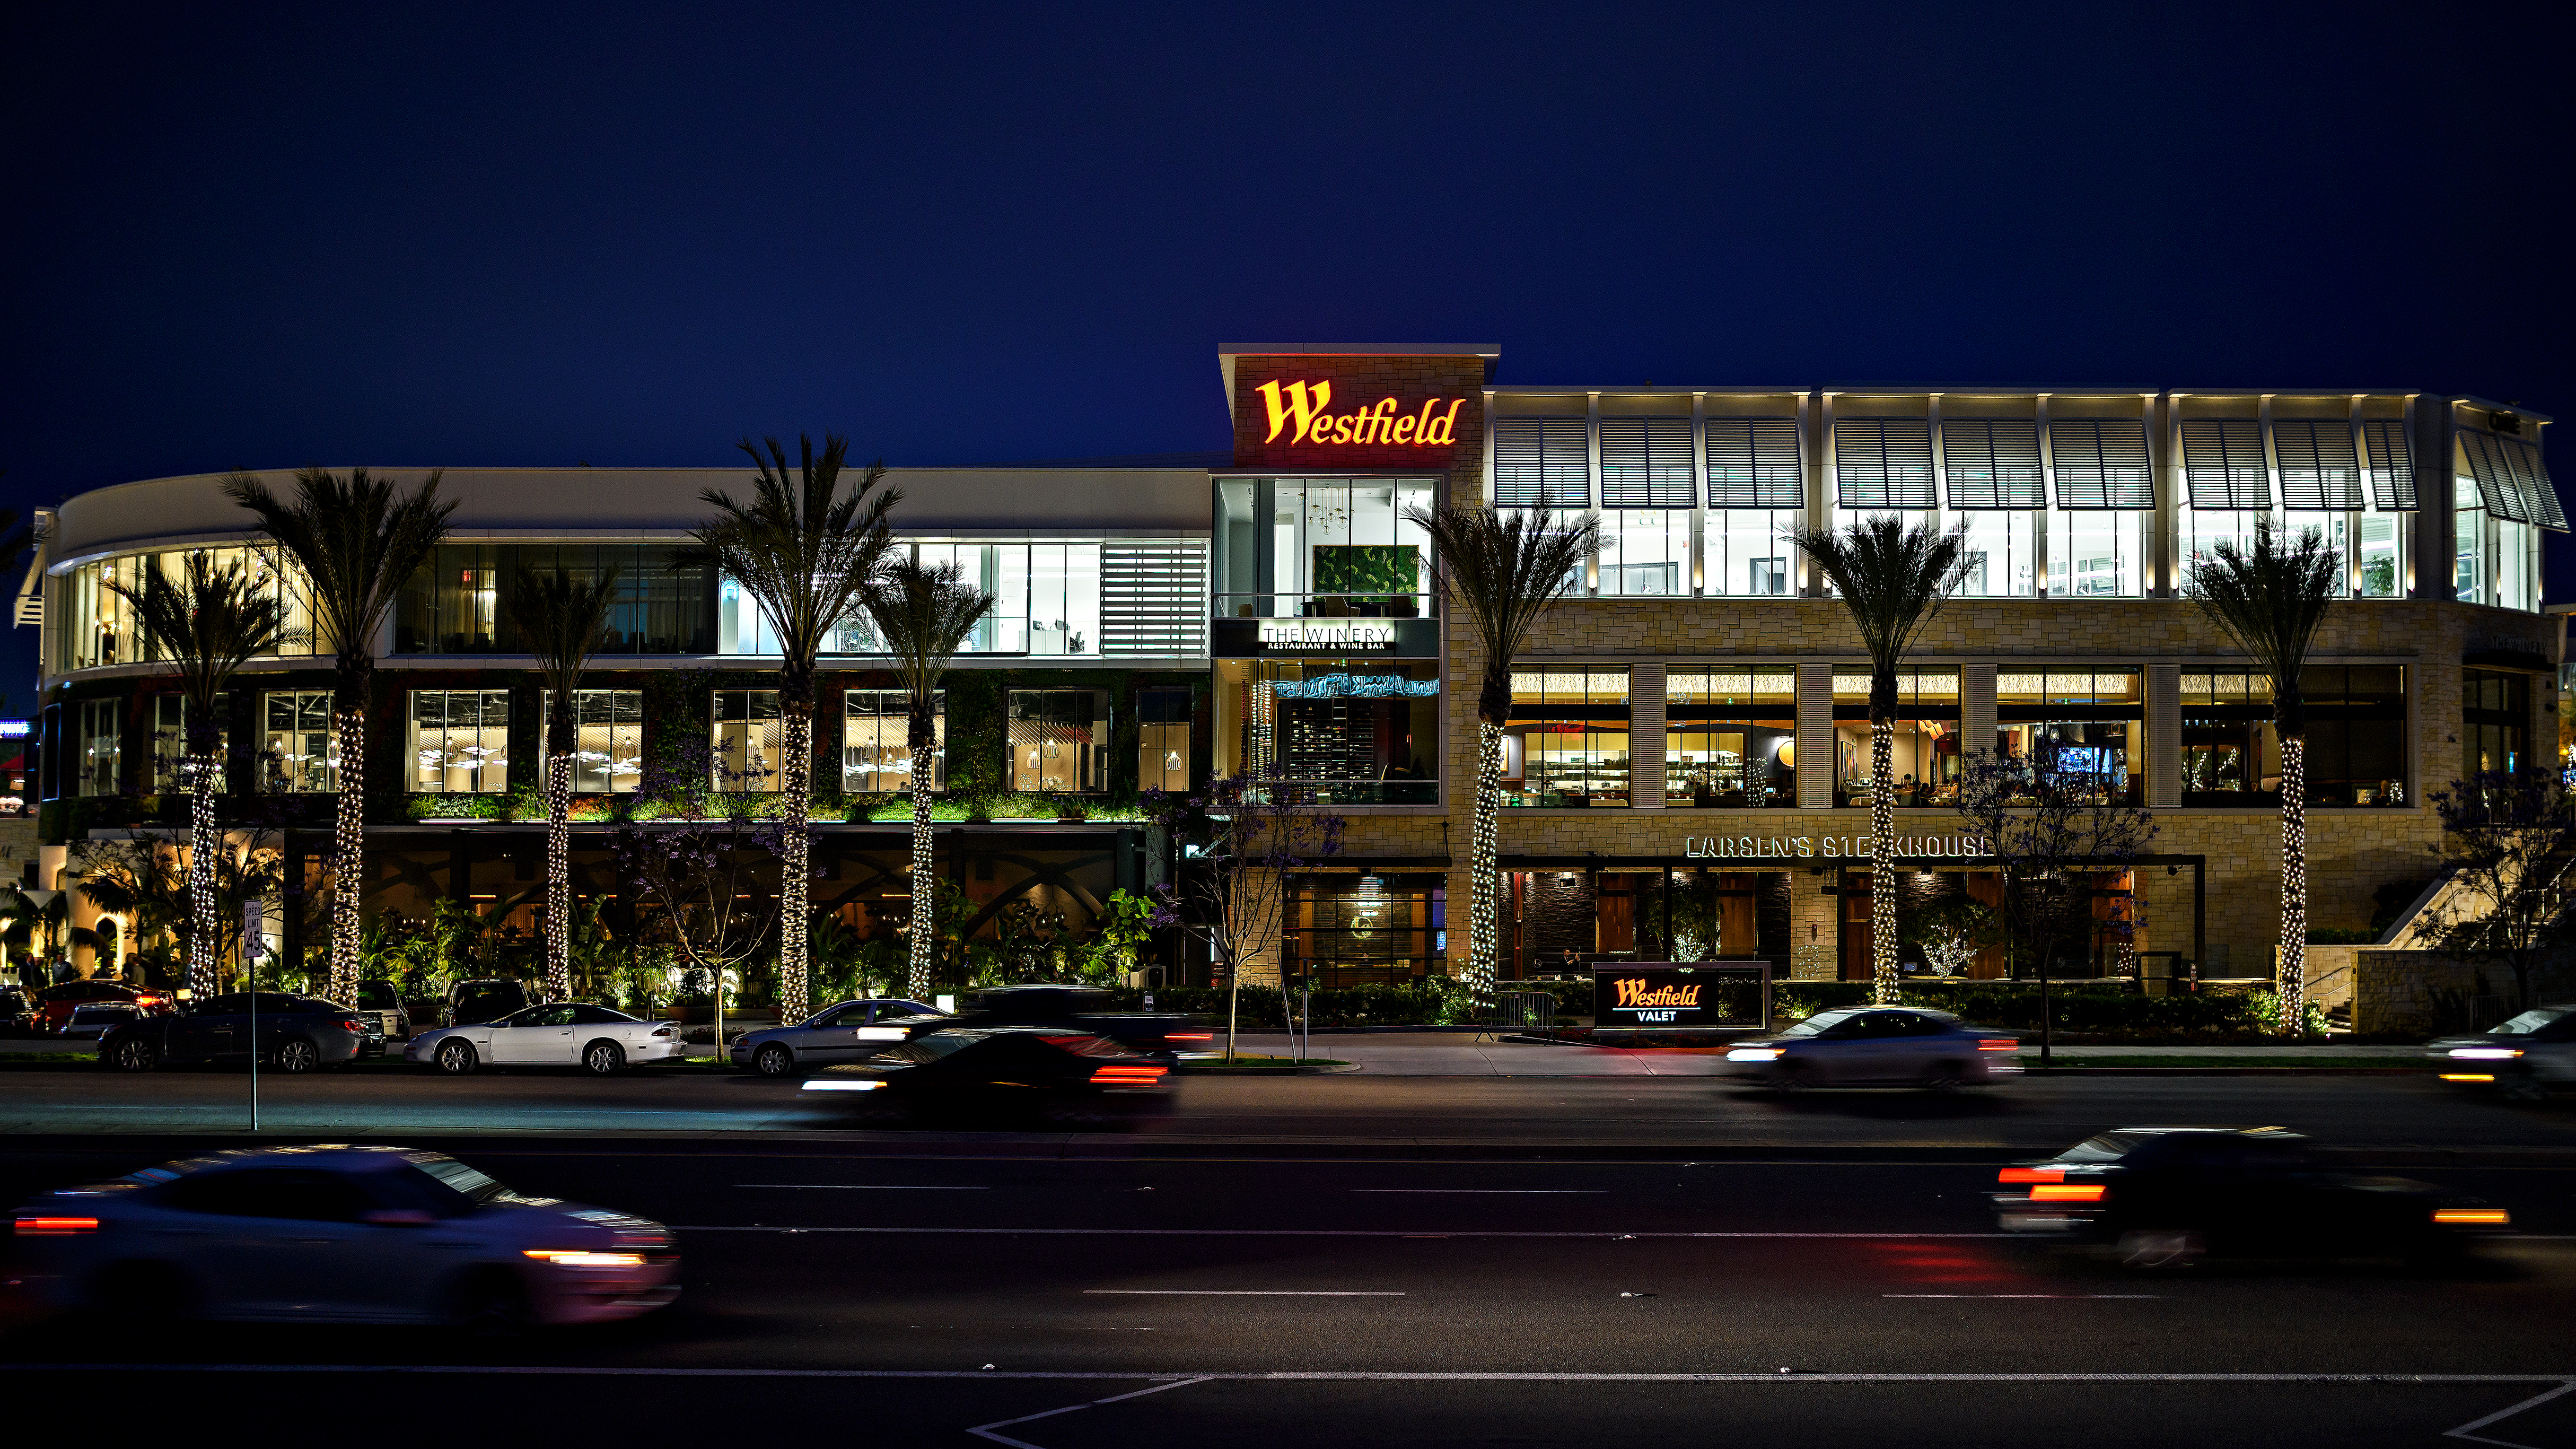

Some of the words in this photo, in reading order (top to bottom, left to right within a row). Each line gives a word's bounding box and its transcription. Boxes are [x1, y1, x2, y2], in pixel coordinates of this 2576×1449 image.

[1255, 378, 1467, 446] Westfield
[1264, 629, 1299, 642] THE
[1306, 629, 1389, 642] WINERY
[1687, 836, 1815, 858] LARSEN'S
[1823, 836, 1995, 857] STEKHOUSE
[246, 907, 260, 916] SPEED
[248, 919, 259, 928] LIMIT
[247, 930, 260, 951] 45
[1614, 978, 1702, 1007] Westfield
[1637, 1011, 1677, 1022] VALET
